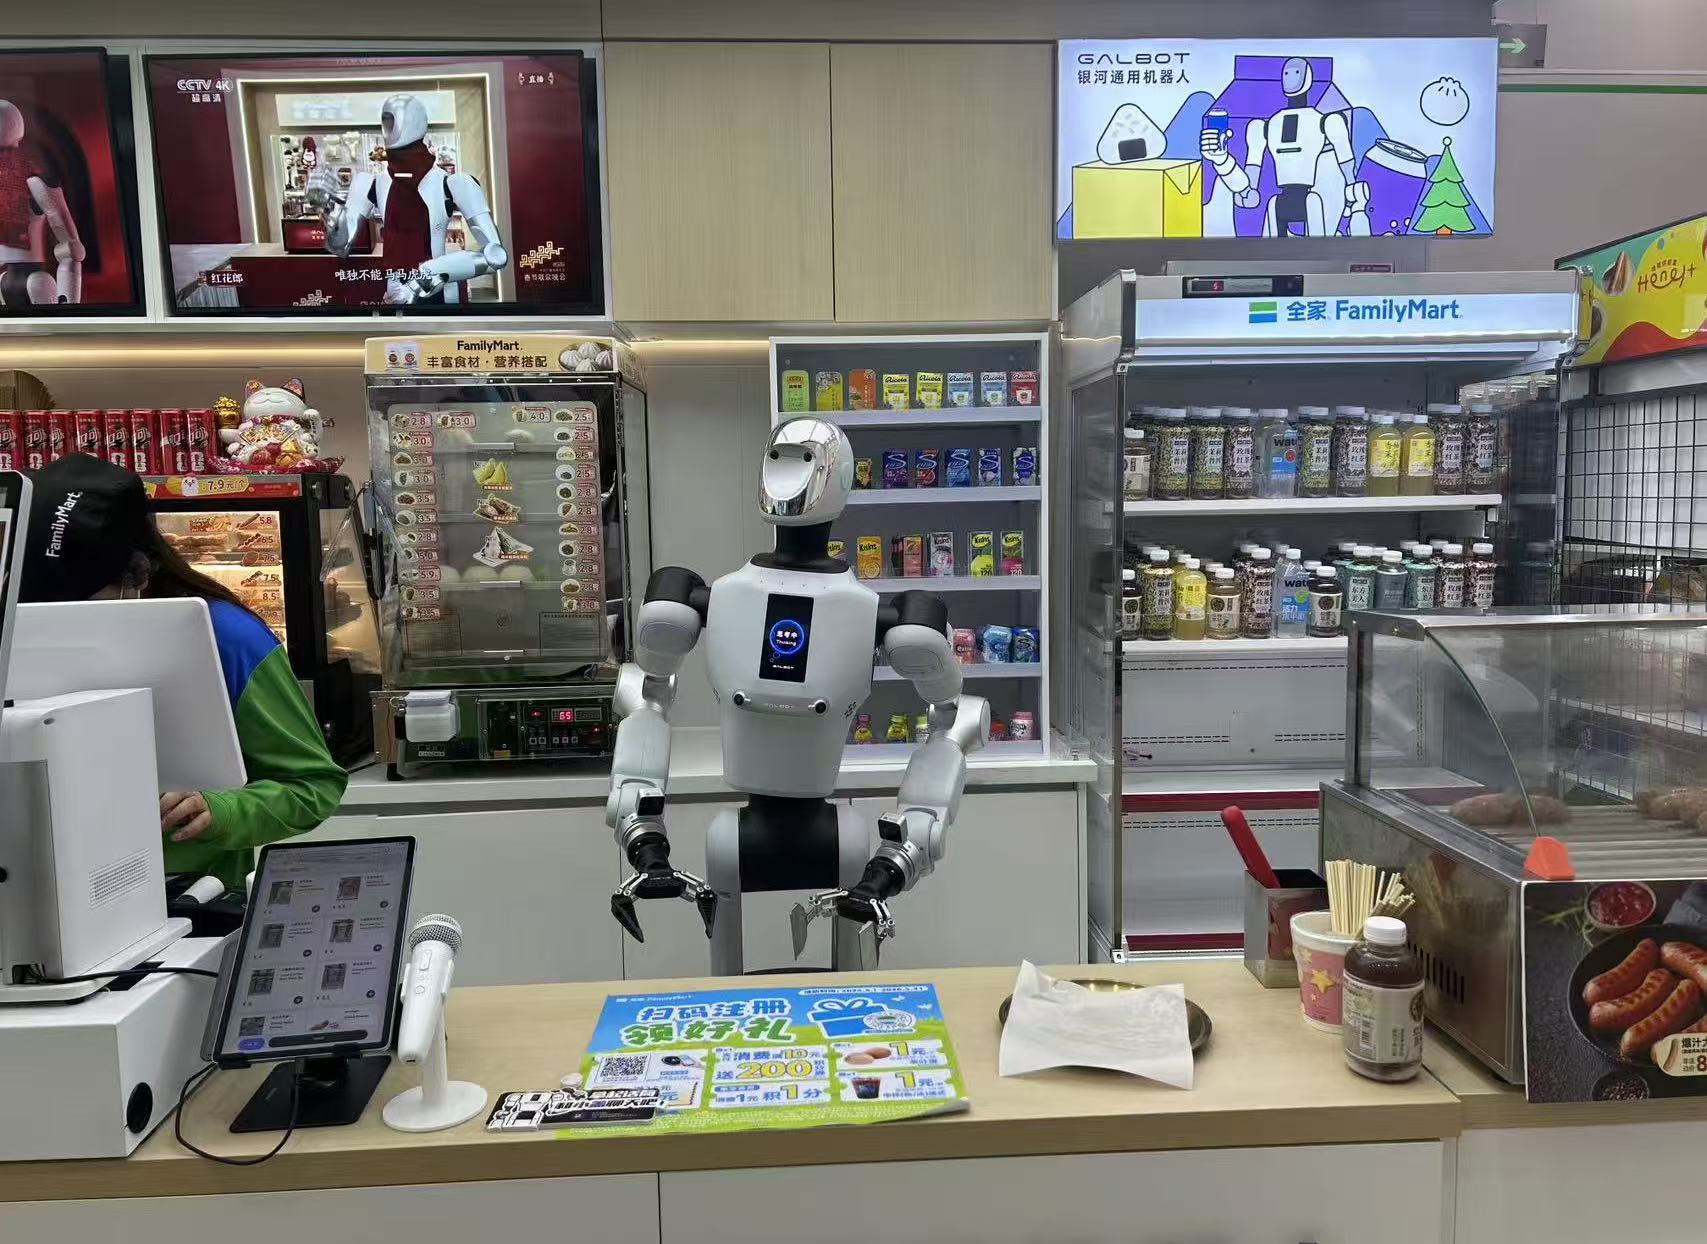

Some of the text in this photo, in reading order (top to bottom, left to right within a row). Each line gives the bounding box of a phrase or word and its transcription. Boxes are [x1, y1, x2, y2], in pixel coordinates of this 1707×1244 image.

[1077, 53, 1190, 65] GALBOT
[1077, 69, 1190, 84] 银河通用机器人
[177, 79, 231, 91] CCTV 4K
[211, 273, 244, 284] 红花郎
[334, 269, 382, 282] 唯独不能
[1286, 299, 1460, 323] 全家 FamilyMart
[457, 340, 520, 353] FamilyMart
[45, 492, 81, 558] FamilyMart
[559, 711, 571, 720] 65
[640, 999, 787, 1021] 扫码注册
[623, 1017, 792, 1045] 领好礼
